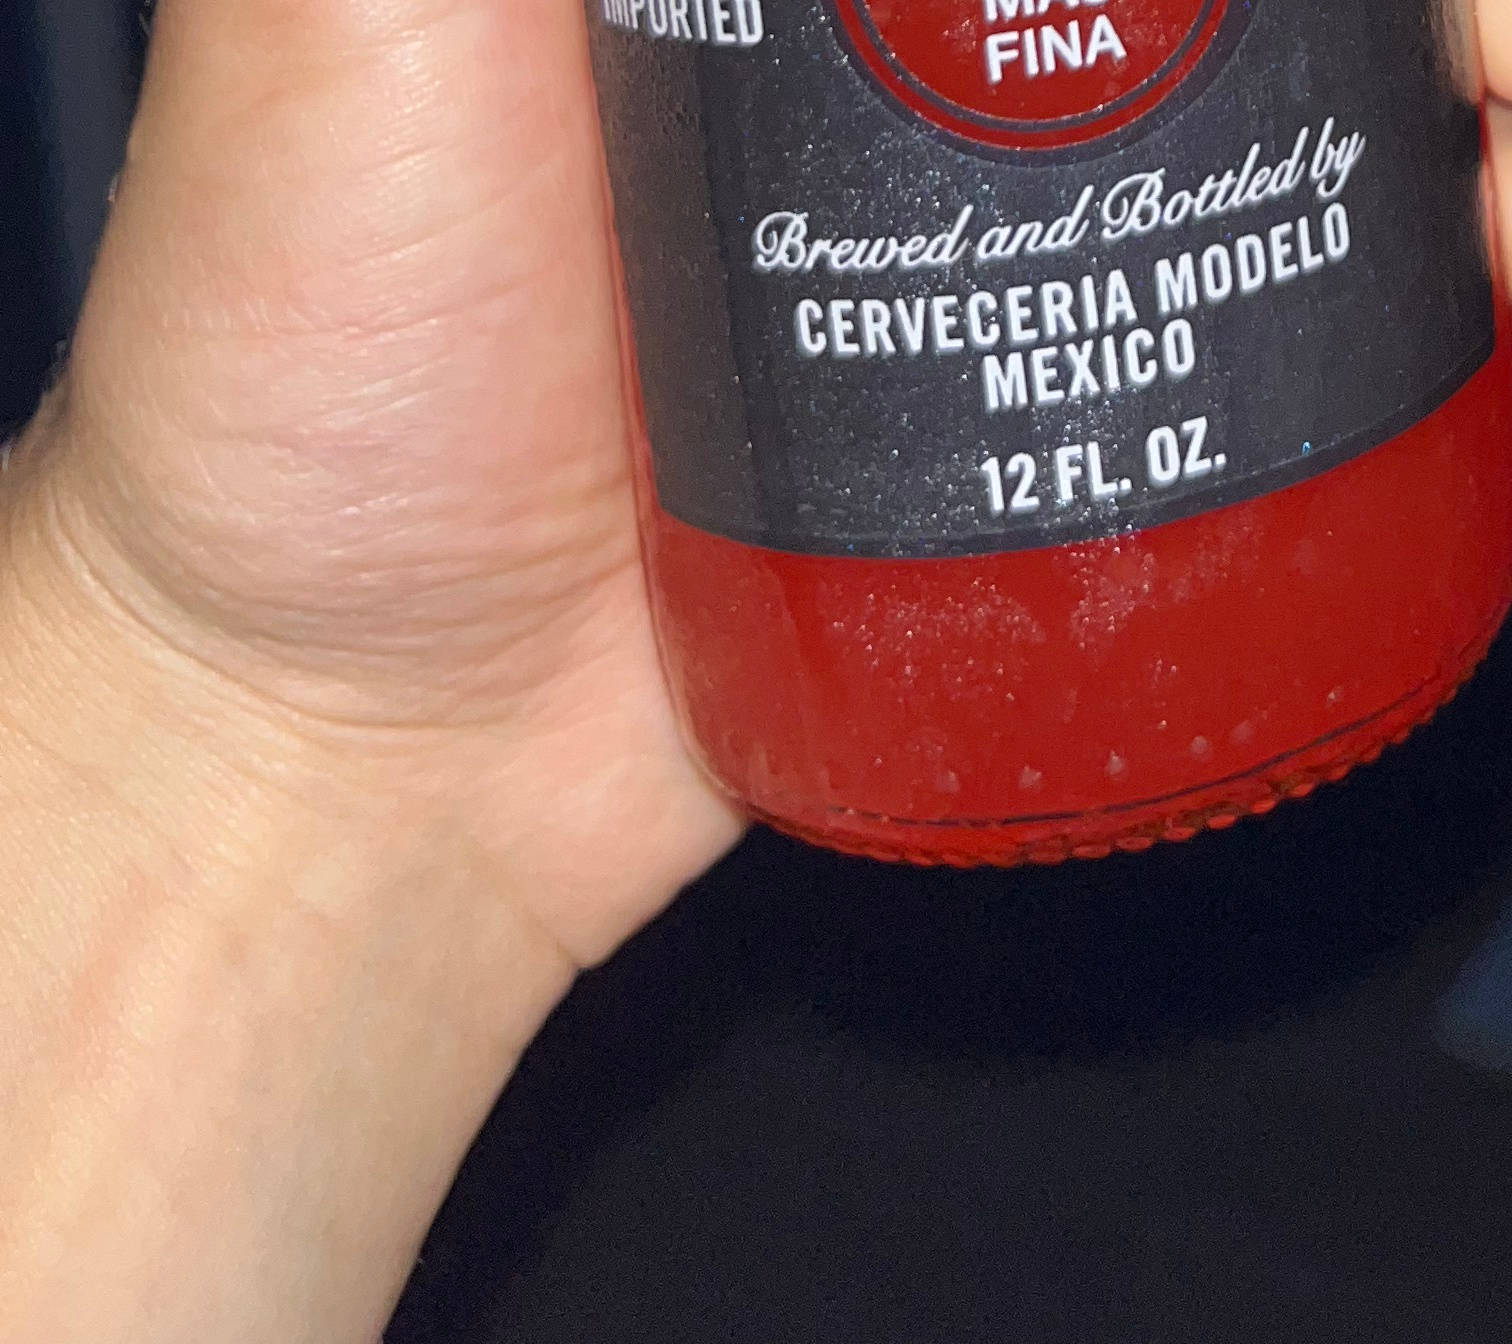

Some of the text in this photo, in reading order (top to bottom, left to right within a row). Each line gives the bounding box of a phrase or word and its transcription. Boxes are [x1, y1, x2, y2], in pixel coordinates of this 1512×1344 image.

[984, 13, 1126, 82] FINA
[753, 115, 1367, 273] Brewed and Bottled by
[796, 201, 1351, 359] CERVECERIA MODELO
[983, 318, 1196, 413] MEXICO
[978, 416, 1228, 512] 12 FL. OZ.
